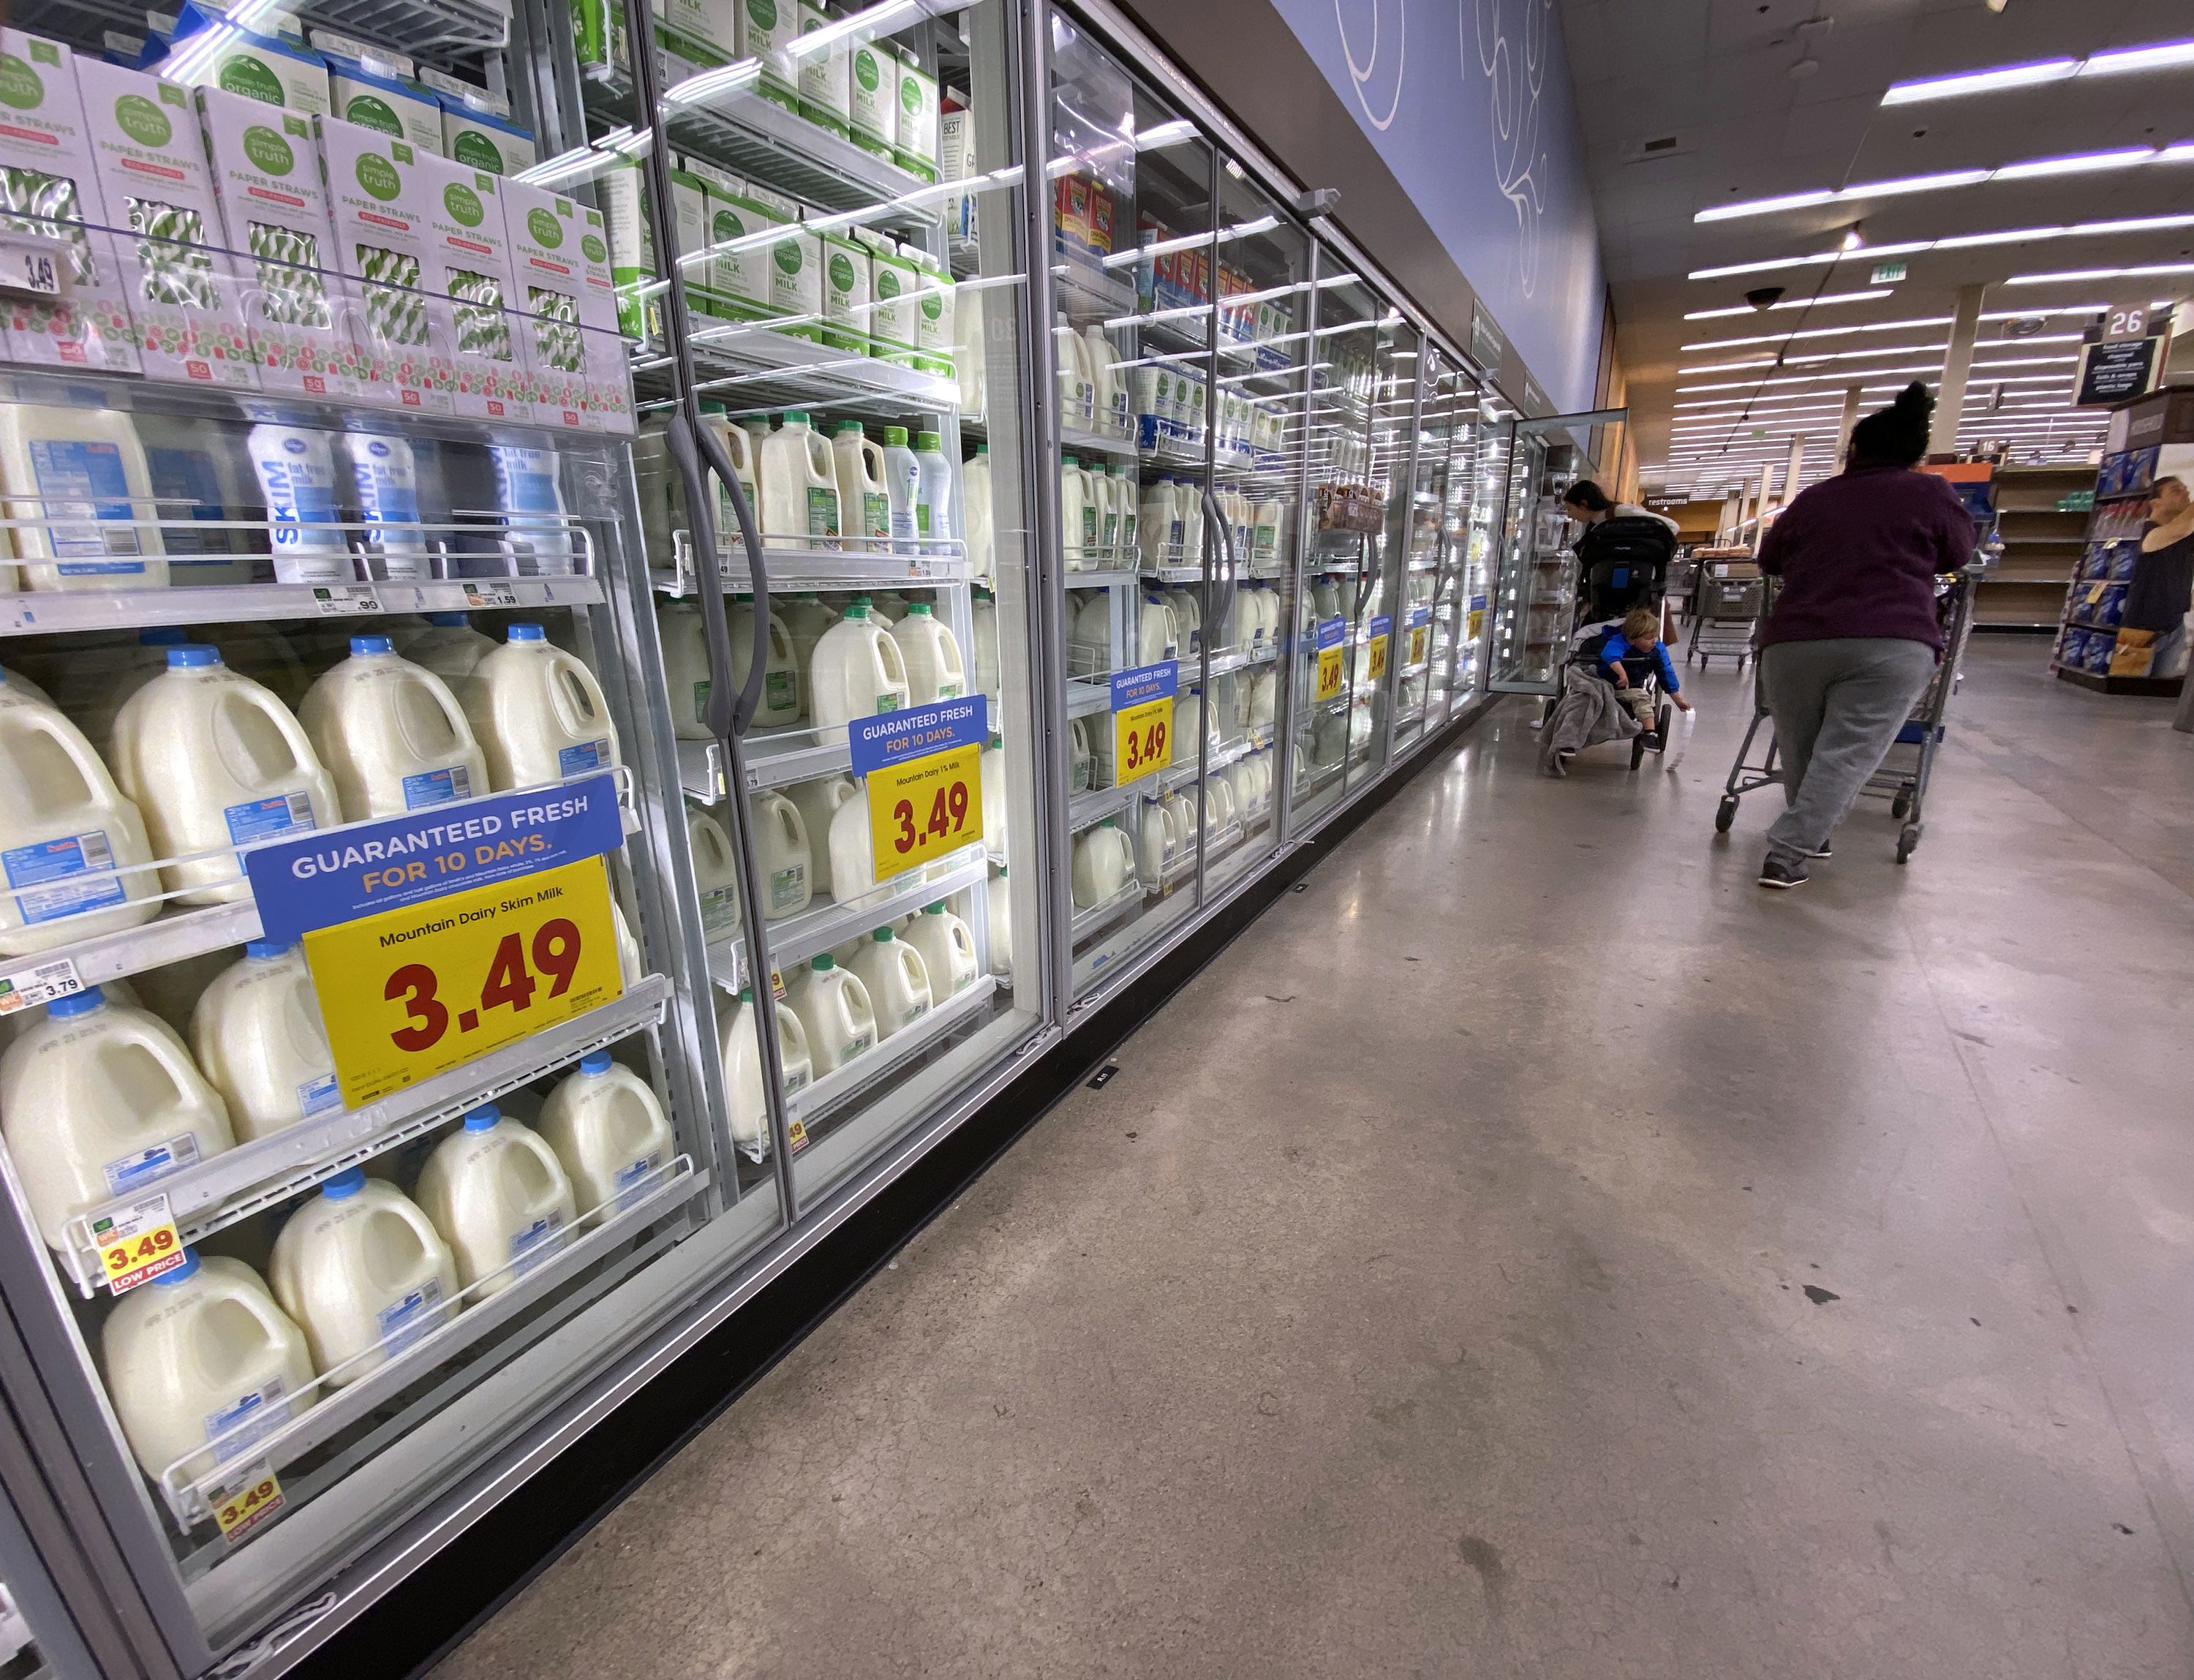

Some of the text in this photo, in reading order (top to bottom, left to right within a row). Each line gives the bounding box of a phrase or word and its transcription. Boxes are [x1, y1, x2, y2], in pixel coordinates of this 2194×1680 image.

[748, 30, 772, 50] MILK
[805, 64, 826, 82] MILK
[226, 82, 280, 105] organic
[856, 91, 875, 107] MILK
[125, 116, 167, 136] truth
[943, 121, 961, 135] BEST
[100, 140, 200, 171] PAPER STRAWS
[252, 147, 289, 165] truth
[459, 154, 500, 173] organic
[363, 165, 394, 180] simple
[363, 173, 396, 189] truth
[229, 170, 318, 200] PAPER STRAWS
[342, 195, 421, 222] PAPER STRAWS
[449, 194, 478, 207] simple
[451, 200, 480, 217] truth
[432, 222, 463, 236] PAPER
[466, 231, 502, 247] STRAWS
[533, 225, 559, 240] truth
[516, 244, 544, 257] PAPER
[547, 252, 579, 268] STRAWS
[715, 258, 741, 274] MILK
[1878, 266, 1901, 281] EXIT
[775, 277, 797, 292] MILK
[831, 295, 850, 308] MILK
[878, 310, 897, 322] MILK
[2109, 310, 2143, 335] 26
[921, 323, 938, 334] MILK
[189, 364, 207, 374] 50
[306, 379, 322, 390] 50
[404, 393, 418, 403] 50
[489, 402, 502, 413] 50
[565, 413, 576, 422] 50
[1983, 440, 1995, 452] 16
[507, 459, 527, 472] milk
[261, 460, 298, 545] SKIM
[1648, 497, 1688, 507] restrooms
[357, 600, 378, 610] .99
[497, 595, 516, 605] 1.59
[1116, 668, 1172, 690] GUARANTEED FRESH
[1322, 663, 1339, 692] 3.49
[1126, 688, 1138, 699] FOR
[1139, 686, 1145, 696] 10
[1145, 682, 1161, 693] DAYS.
[863, 705, 973, 740] GUARANTEED FRESH
[886, 737, 909, 753] FOR
[912, 734, 924, 746] 10
[927, 726, 956, 743] DAYS.
[1127, 721, 1166, 769] 3.49
[896, 761, 960, 787] Mountain Dairy 1% Milk
[894, 780, 968, 854] 3.49
[292, 795, 588, 879] GUARANTEED FRESH
[363, 834, 553, 893] FOR 10 DAYS.
[380, 886, 564, 949] Mountain Dairy Skim Milk
[45, 979, 78, 996] 3.79
[384, 918, 582, 1053] 3.49
[108, 1229, 173, 1270] 3.49
[115, 1254, 183, 1289] LOW PRICE
[222, 1480, 274, 1524] 3.49
[227, 1496, 283, 1539] LOW PRICE
